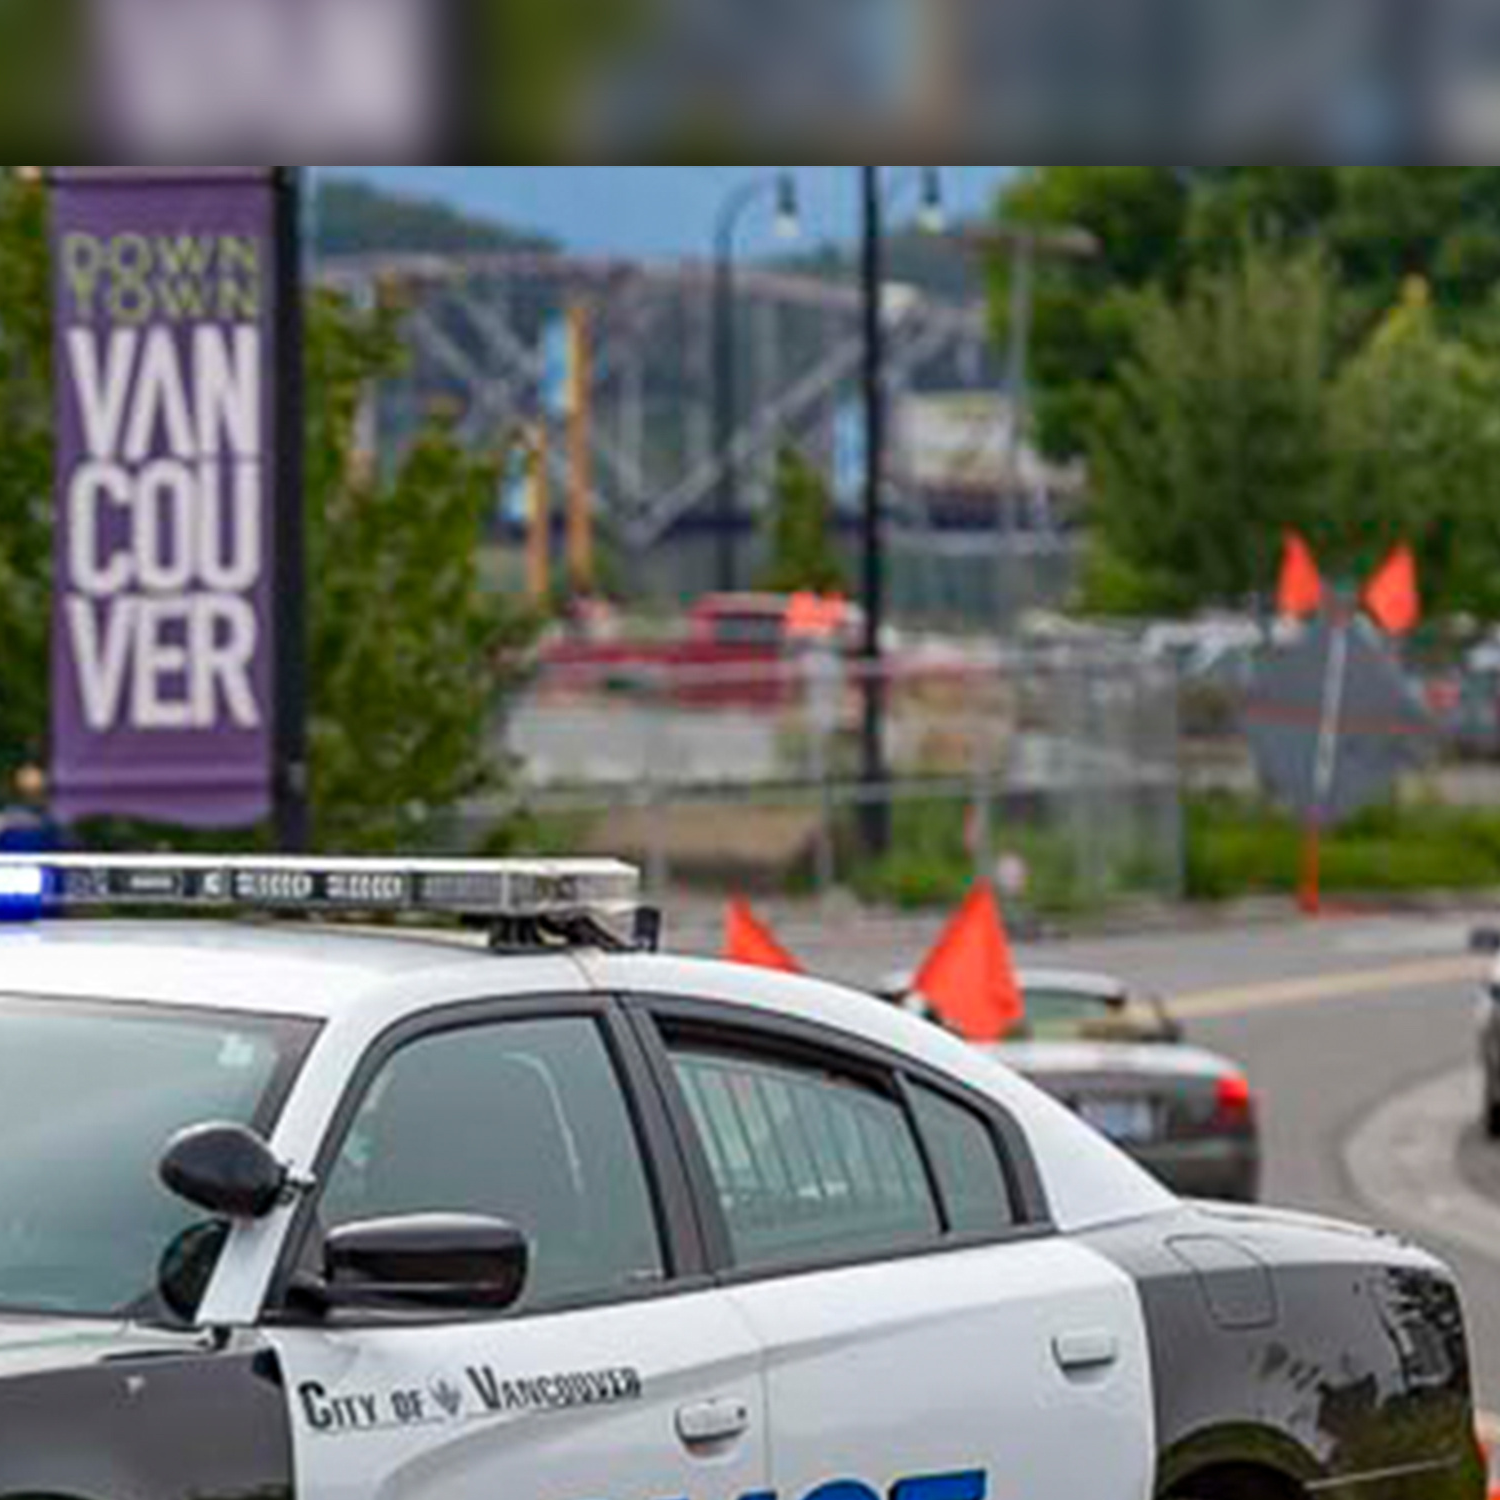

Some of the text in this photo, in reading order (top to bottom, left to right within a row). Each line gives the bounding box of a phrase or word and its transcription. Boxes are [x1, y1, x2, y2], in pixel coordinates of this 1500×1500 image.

[63, 233, 260, 276] DOWN
[68, 274, 260, 324] TOWN
[66, 325, 260, 461] VAN
[68, 459, 260, 594] COU
[66, 594, 260, 729] VER
